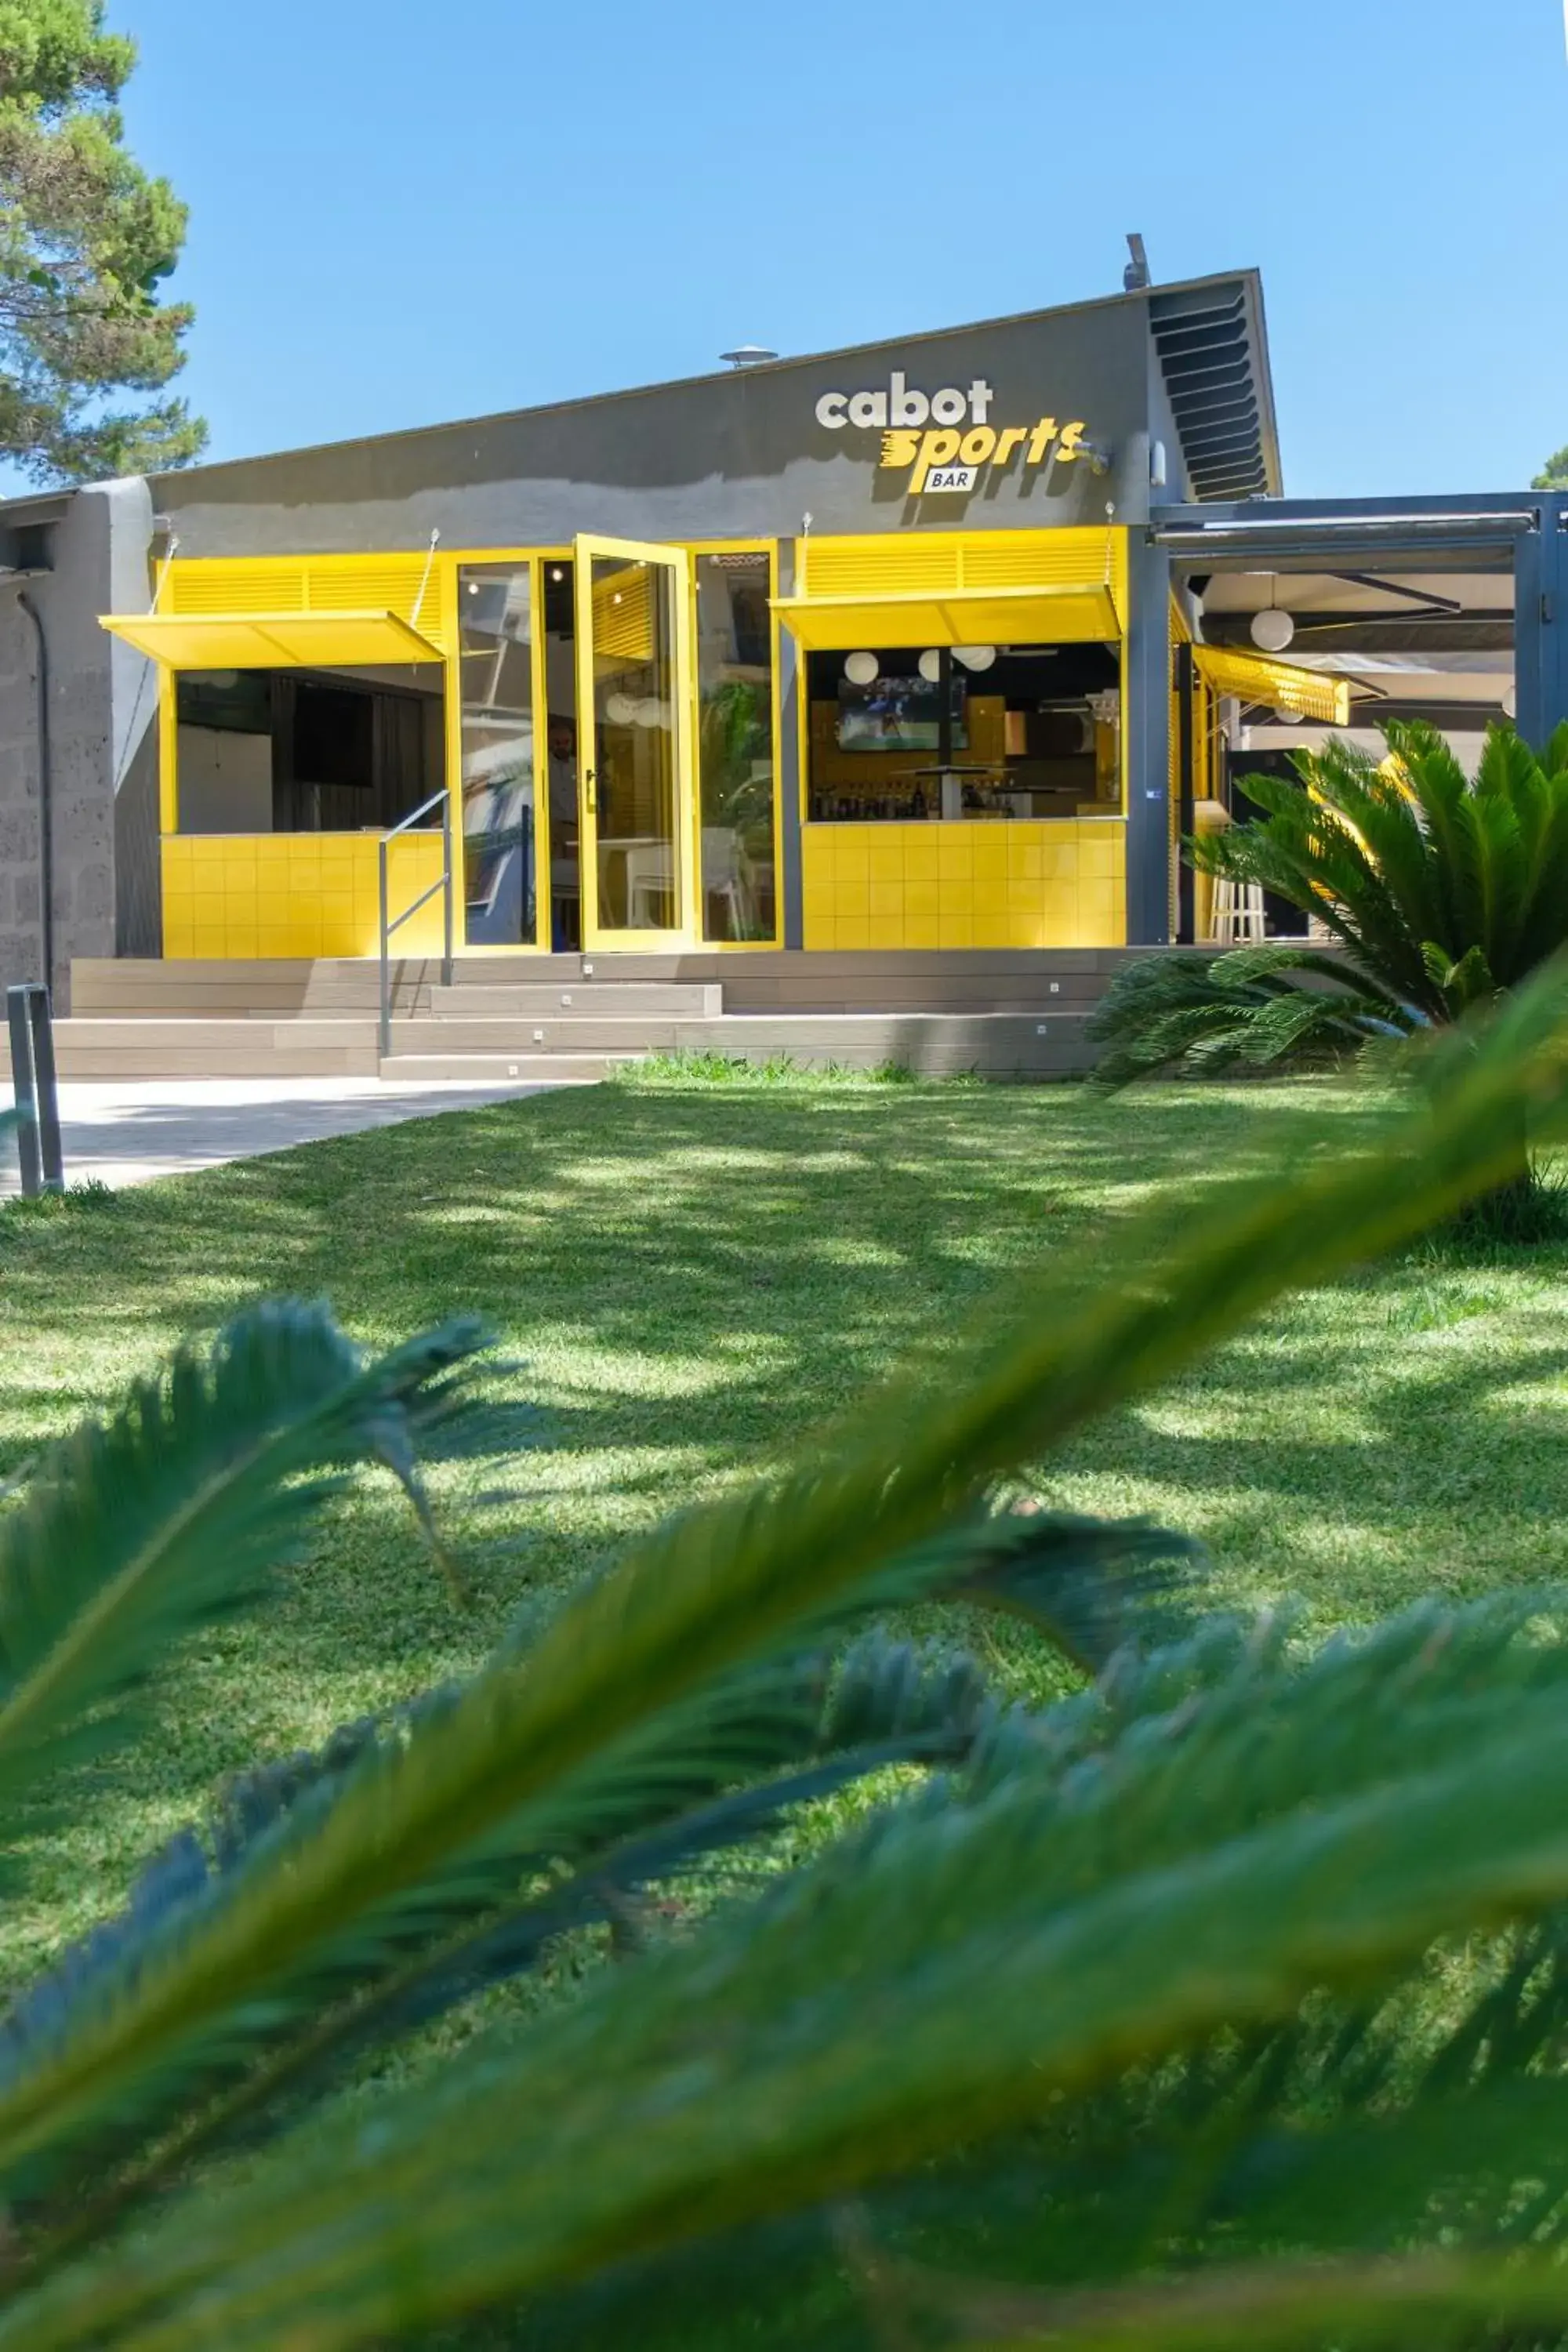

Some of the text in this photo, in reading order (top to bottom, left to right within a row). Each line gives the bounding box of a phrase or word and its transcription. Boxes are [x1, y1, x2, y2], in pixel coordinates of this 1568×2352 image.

[815, 372, 993, 429] cabot
[879, 417, 1085, 494] sports
[931, 472, 968, 487] BAR
